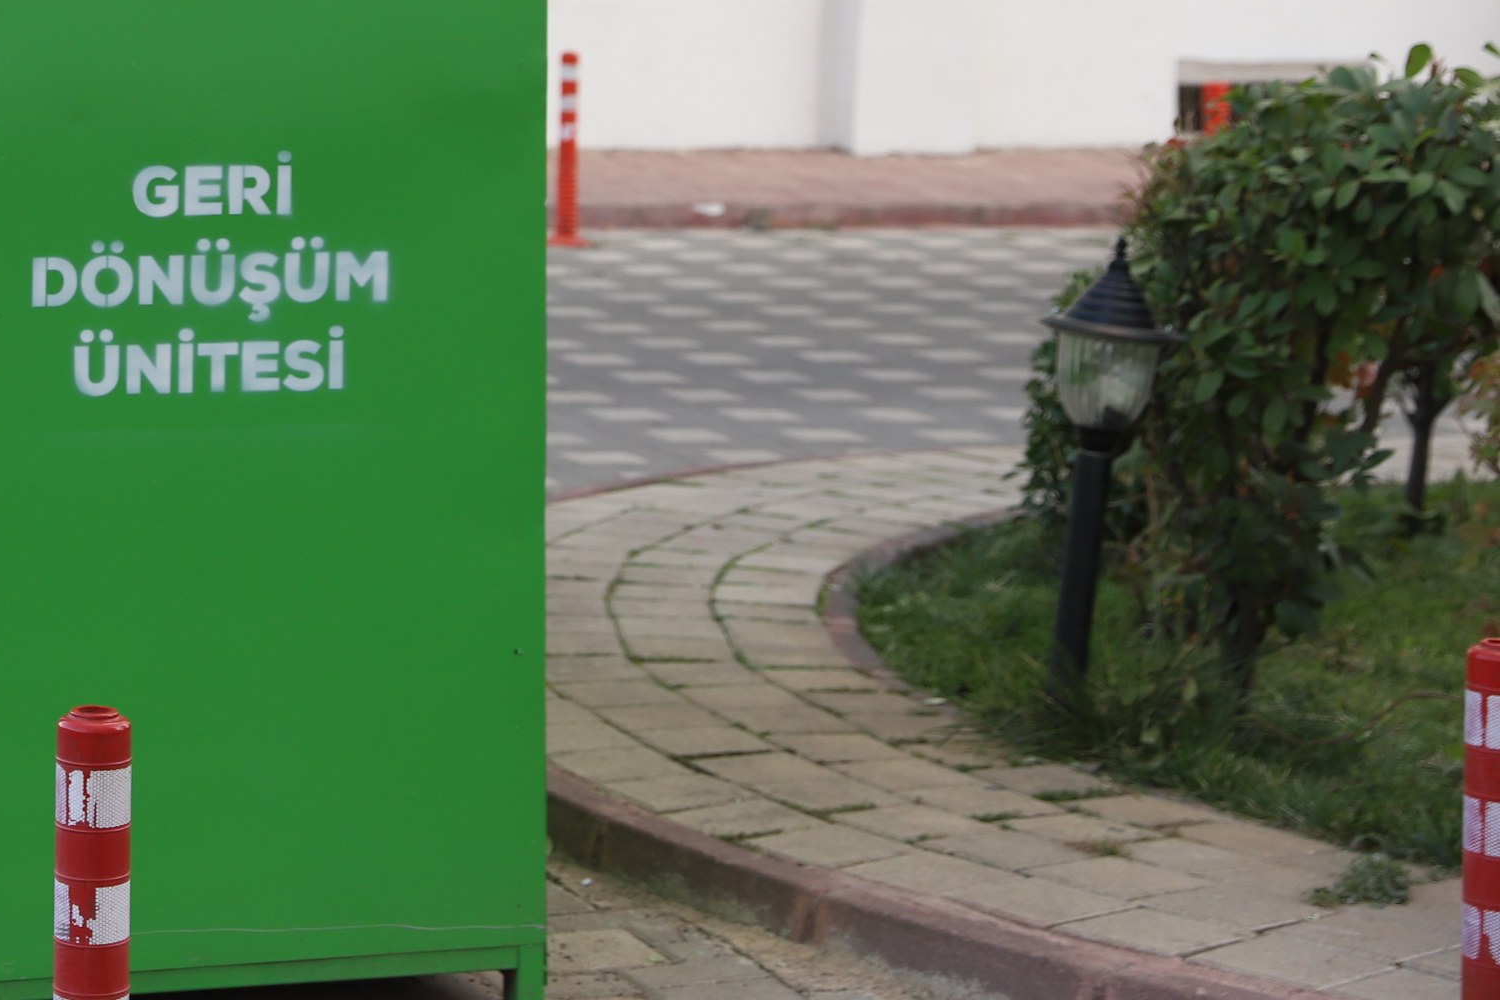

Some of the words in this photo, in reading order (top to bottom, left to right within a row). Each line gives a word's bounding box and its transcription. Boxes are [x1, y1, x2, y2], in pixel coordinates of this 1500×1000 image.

[132, 150, 292, 218] GERİ
[31, 236, 390, 322] DÖNÜŞÜM
[74, 325, 344, 397] ÜNİTESİ
